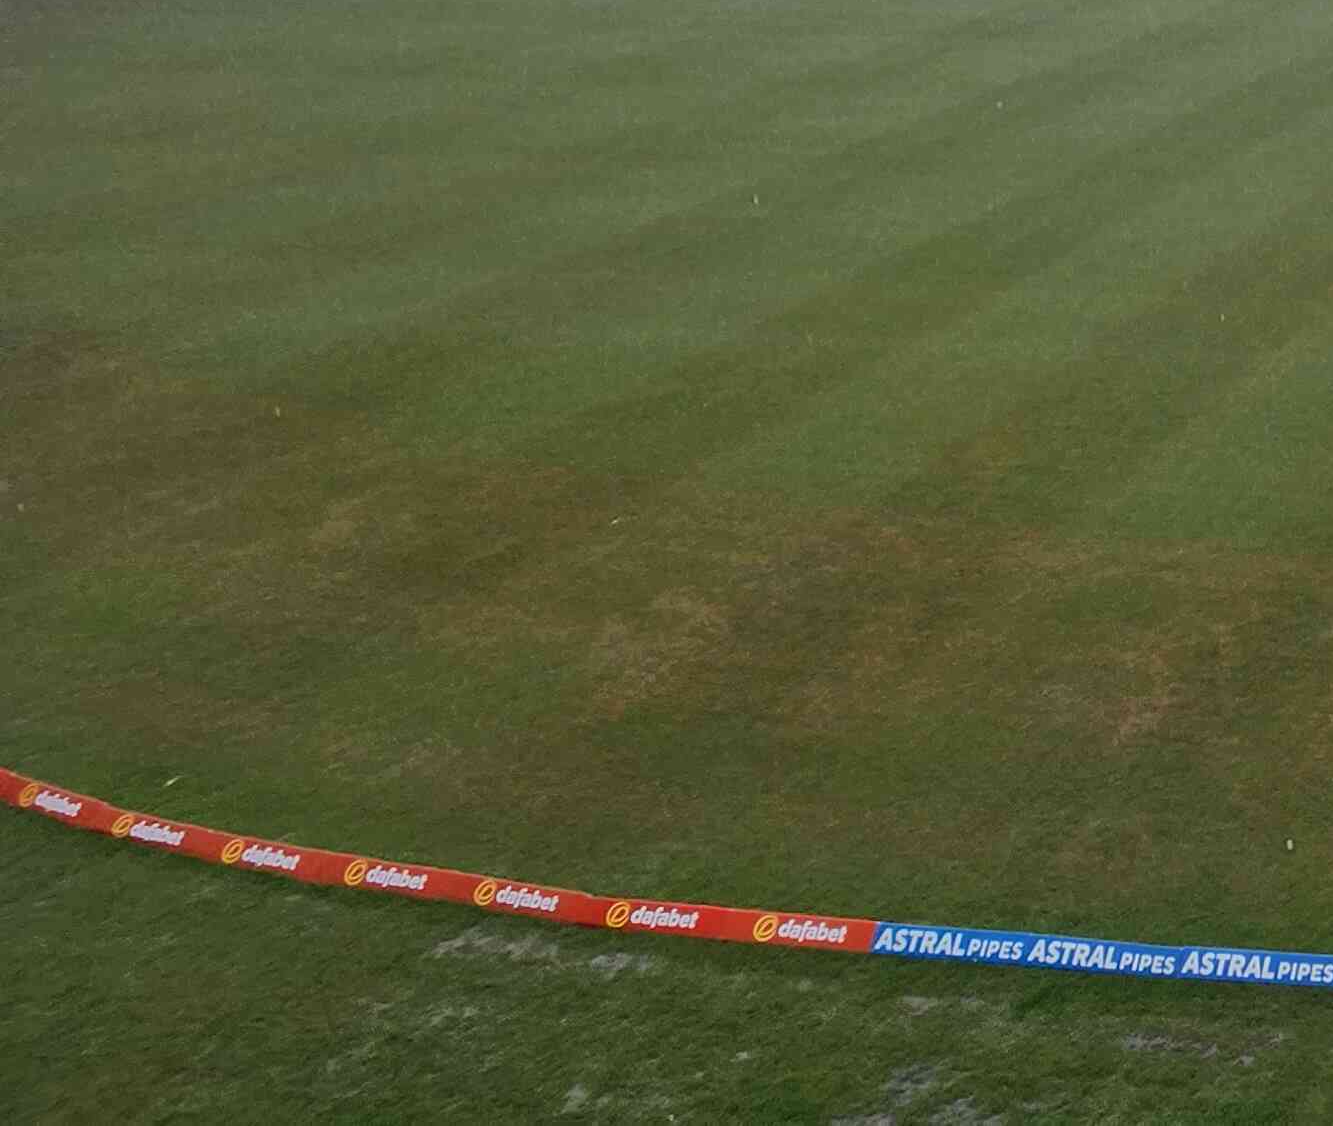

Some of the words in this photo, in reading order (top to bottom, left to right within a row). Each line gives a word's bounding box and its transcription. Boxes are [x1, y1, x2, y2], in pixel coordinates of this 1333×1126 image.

[35, 789, 82, 817] dafabet
[130, 819, 184, 846] dafabet
[242, 844, 302, 871] dafabet
[366, 865, 428, 891] dafabet
[496, 884, 560, 913] dafabet
[630, 905, 700, 931] dafabet
[777, 918, 848, 945] dafabet
[875, 927, 967, 957] ASTRAL
[966, 937, 1023, 961] PIPES
[1028, 939, 1118, 970] ASTRAL
[1119, 951, 1176, 975] PIPES
[1181, 951, 1276, 980] ASTRAL
